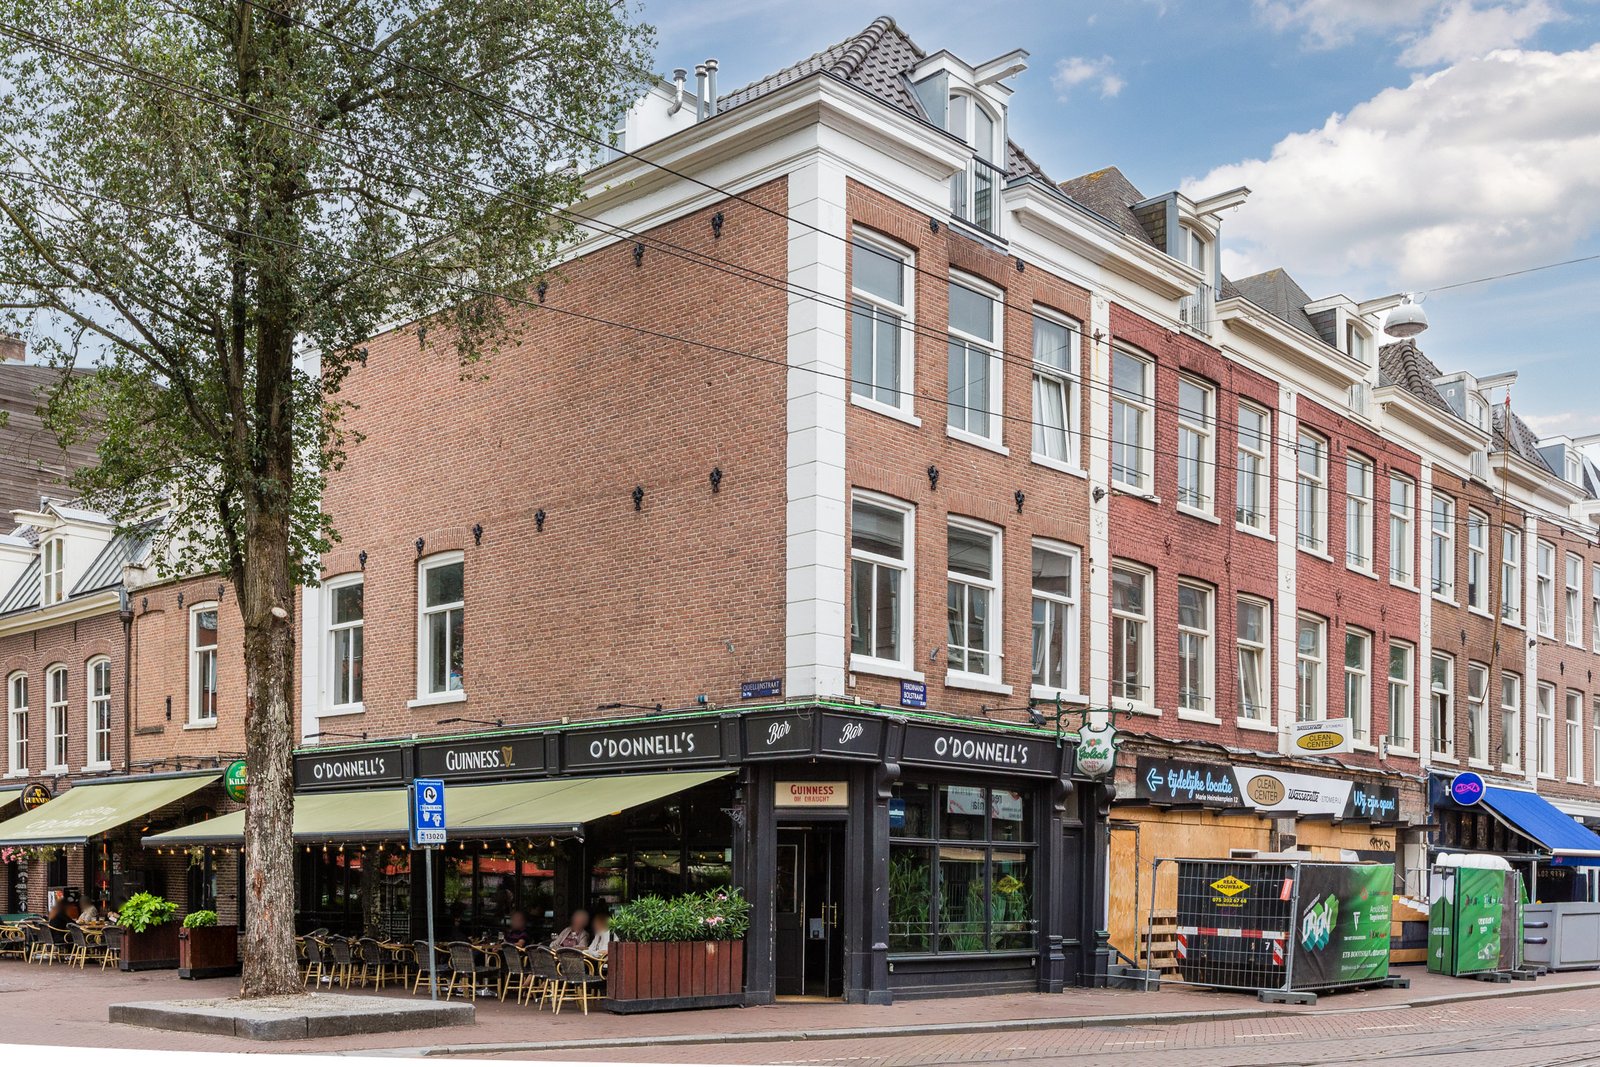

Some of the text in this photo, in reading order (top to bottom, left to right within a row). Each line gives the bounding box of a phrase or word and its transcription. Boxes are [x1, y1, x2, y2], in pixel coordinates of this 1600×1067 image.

[766, 721, 791, 745] Bar
[839, 722, 864, 744] Bar
[1309, 734, 1332, 742] CLEAN
[589, 732, 696, 758] O'DONNELL'S
[934, 736, 1028, 764] O'DONNELL'S
[1078, 746, 1109, 761] Grolsch
[1306, 740, 1334, 748] CENTER
[313, 757, 385, 779] O'DONNELL'S
[445, 750, 500, 771] GUINNESS
[790, 784, 834, 795] GUINNESS
[1167, 769, 1233, 799] tijdelijke locatie
[1256, 779, 1277, 790] CLEAN
[1254, 789, 1278, 801] CENTER
[1353, 790, 1395, 817] Wij zijn open!
[1265, 942, 1270, 951] 7
